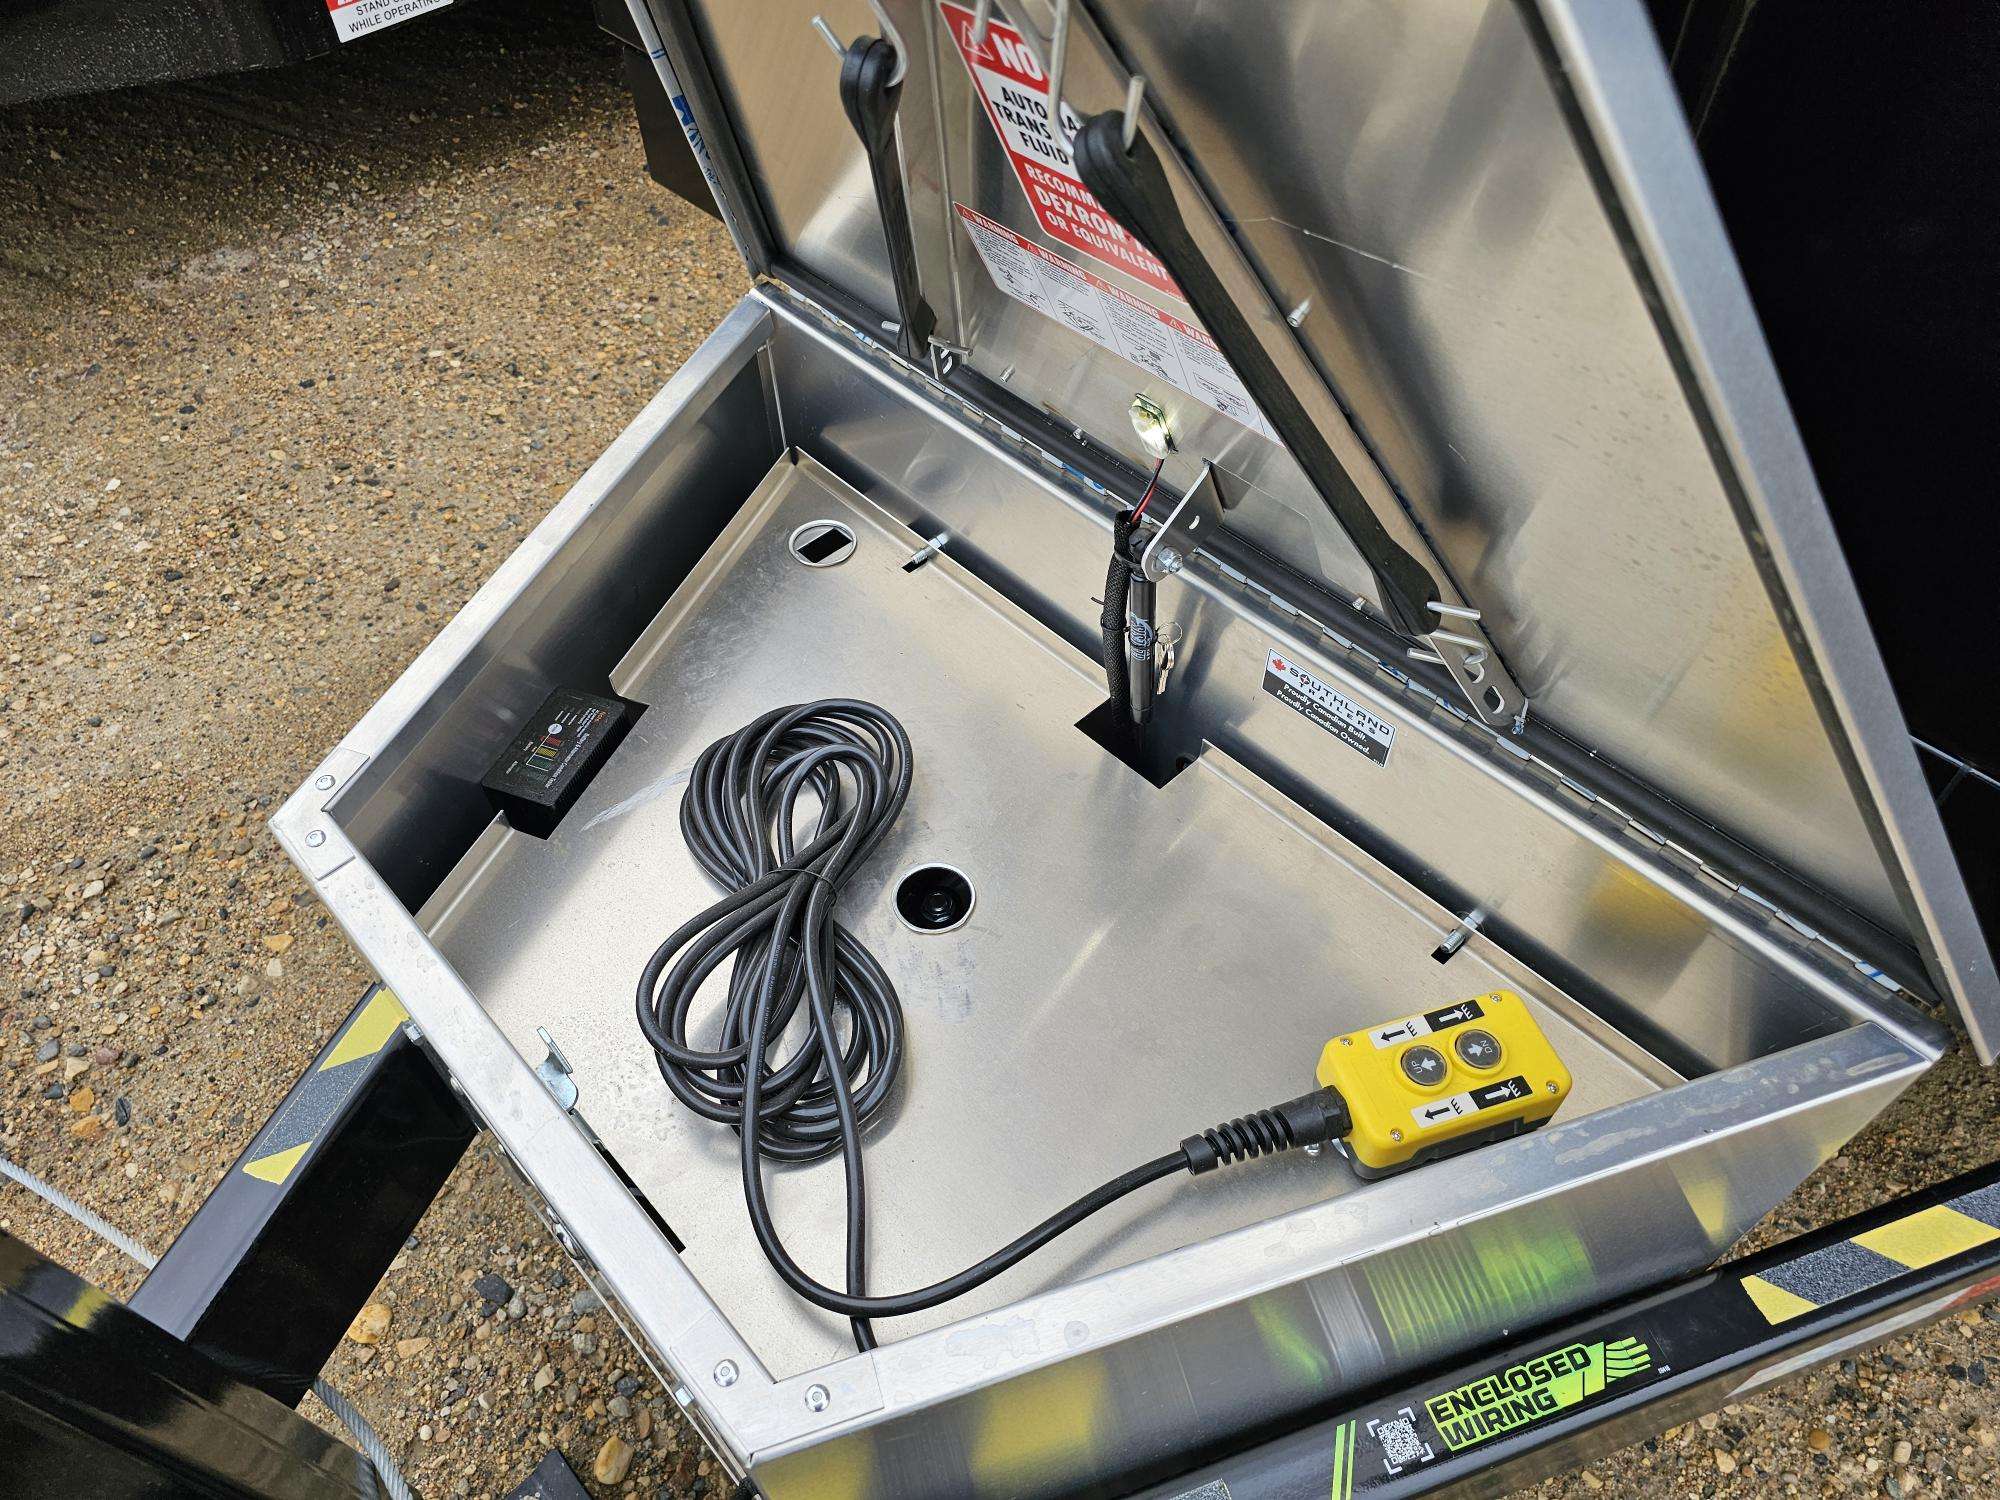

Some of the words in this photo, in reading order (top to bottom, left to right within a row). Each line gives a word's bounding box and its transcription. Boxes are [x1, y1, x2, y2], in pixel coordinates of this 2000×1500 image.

[349, 13, 382, 32] WHILE
[384, 0, 440, 20] OPERATIN
[1019, 131, 1069, 165] FLUID
[972, 213, 1019, 244] WARNING
[1033, 184, 1128, 245] DEXRON
[1039, 248, 1086, 280] WARNING
[1045, 210, 1070, 233] OR
[1071, 222, 1168, 281] EQUIVALENT
[1108, 285, 1160, 319] WARNING
[1277, 690, 1303, 711] Proudly
[1306, 709, 1338, 734] Canadian
[1340, 731, 1370, 755] Owned.
[1283, 684, 1311, 705] Proudly
[1313, 703, 1346, 728] Canadian
[1348, 726, 1367, 742] Built.
[1289, 667, 1389, 735] SOUTHLAND
[1299, 681, 1376, 734] TRAILERS
[1411, 1060, 1423, 1074] UP
[1480, 1040, 1493, 1054] DN
[1428, 1346, 1592, 1423] ENCLOSED
[1441, 1387, 1558, 1447] WIRING
